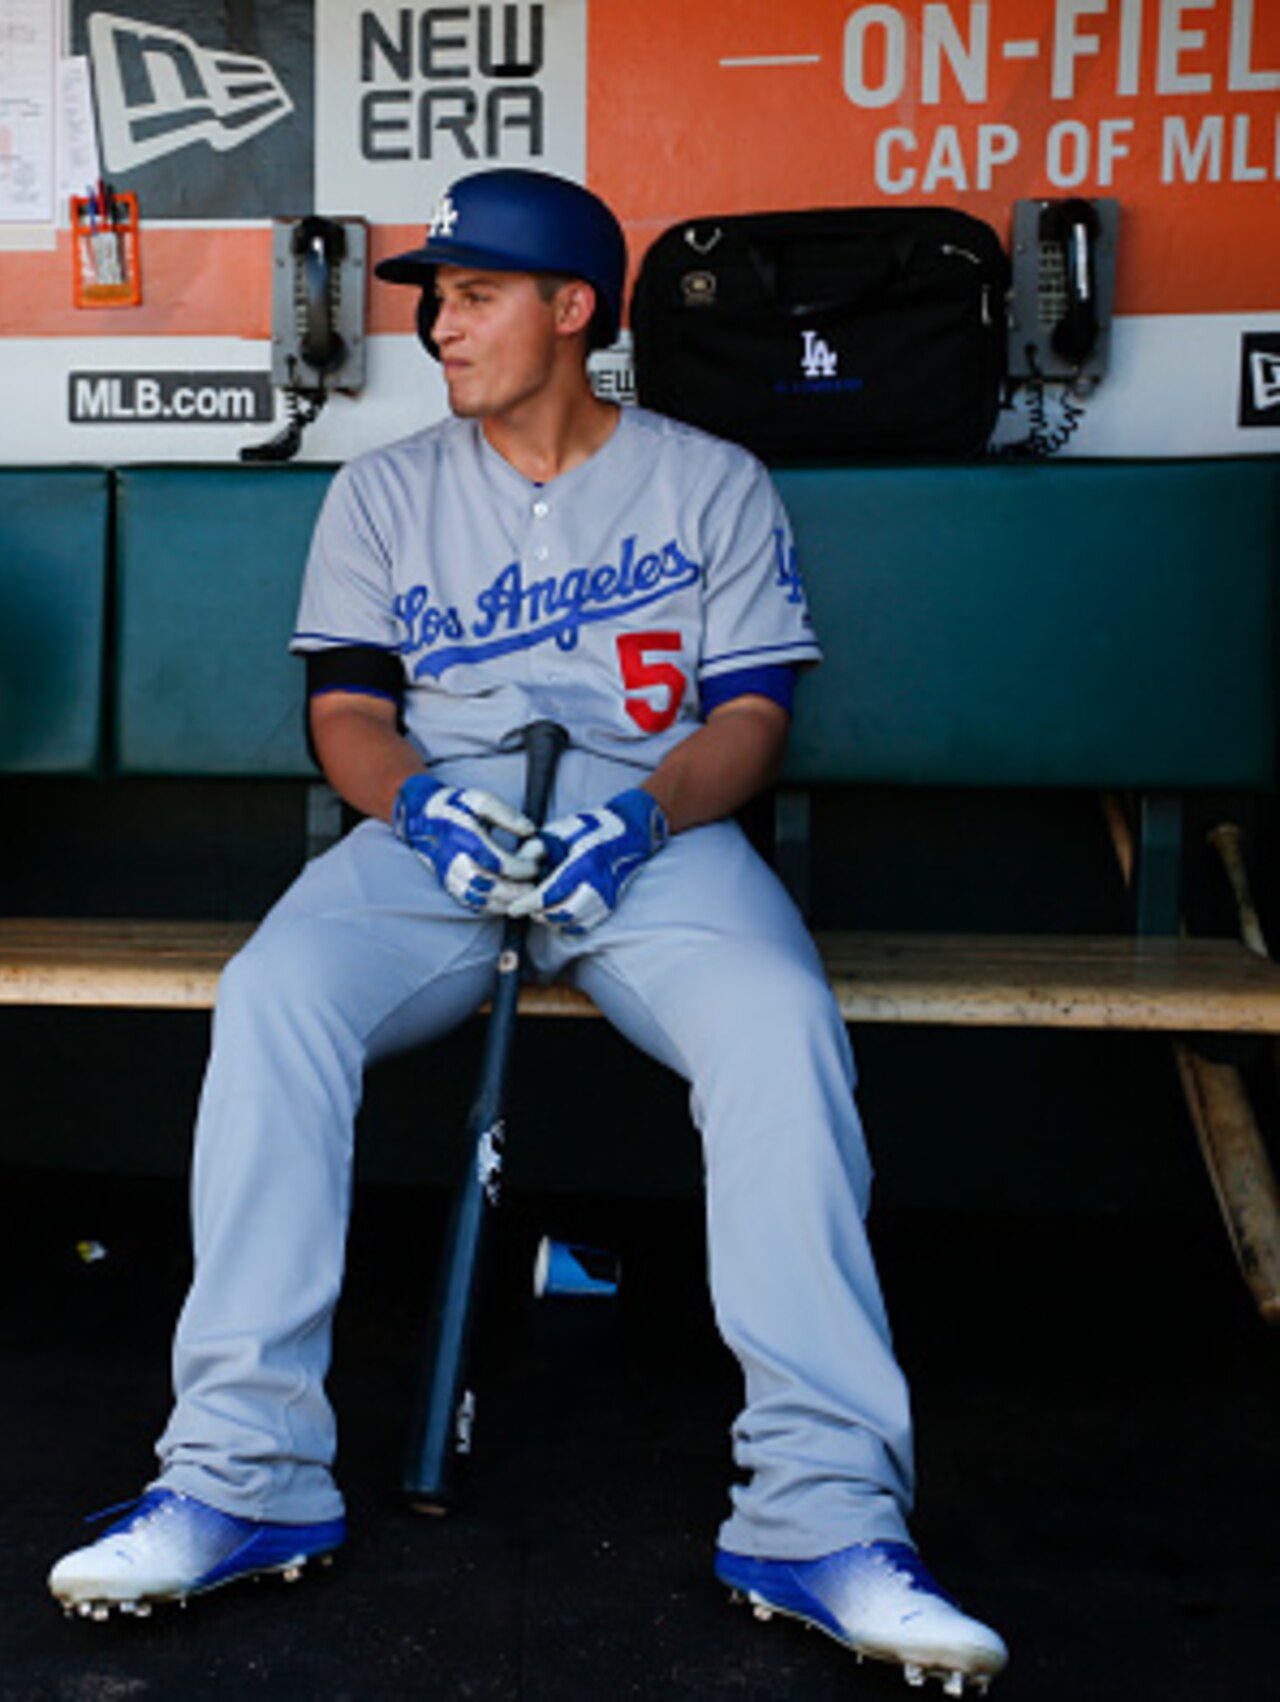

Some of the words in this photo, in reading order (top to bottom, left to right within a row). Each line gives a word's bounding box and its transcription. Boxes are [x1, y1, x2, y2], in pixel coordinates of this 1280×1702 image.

[360, 3, 544, 82] NEW
[360, 85, 544, 161] ERA
[874, 124, 1018, 195] CAP
[1045, 119, 1134, 188] OF
[1161, 114, 1280, 184] ML
[801, 331, 837, 376] LA
[76, 378, 255, 418] MLB.com
[395, 584, 465, 654] Los
[473, 535, 692, 652] Angeles
[616, 630, 687, 733] 5
